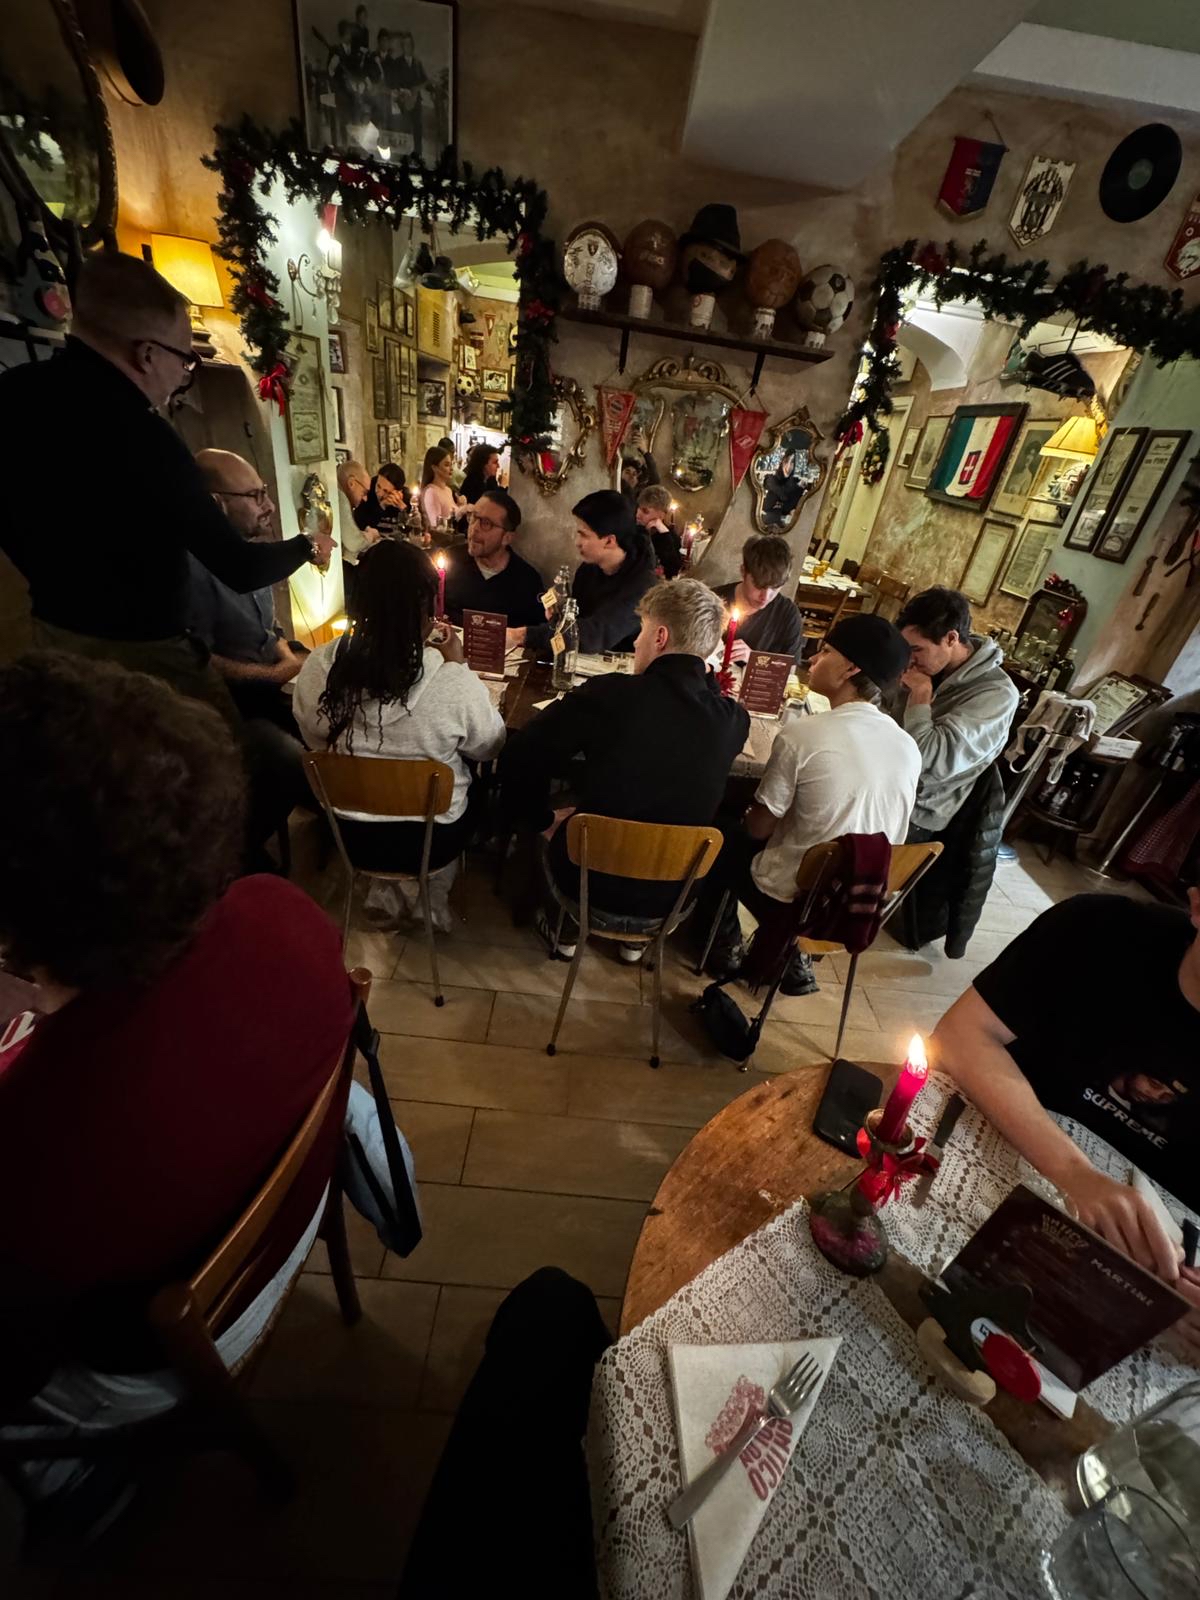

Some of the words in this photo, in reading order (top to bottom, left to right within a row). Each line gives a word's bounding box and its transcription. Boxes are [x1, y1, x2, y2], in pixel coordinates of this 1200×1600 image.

[1082, 1087, 1169, 1149] SUPREME
[1090, 1258, 1154, 1307] MARTINI
[748, 1417, 794, 1501] ANTICO
